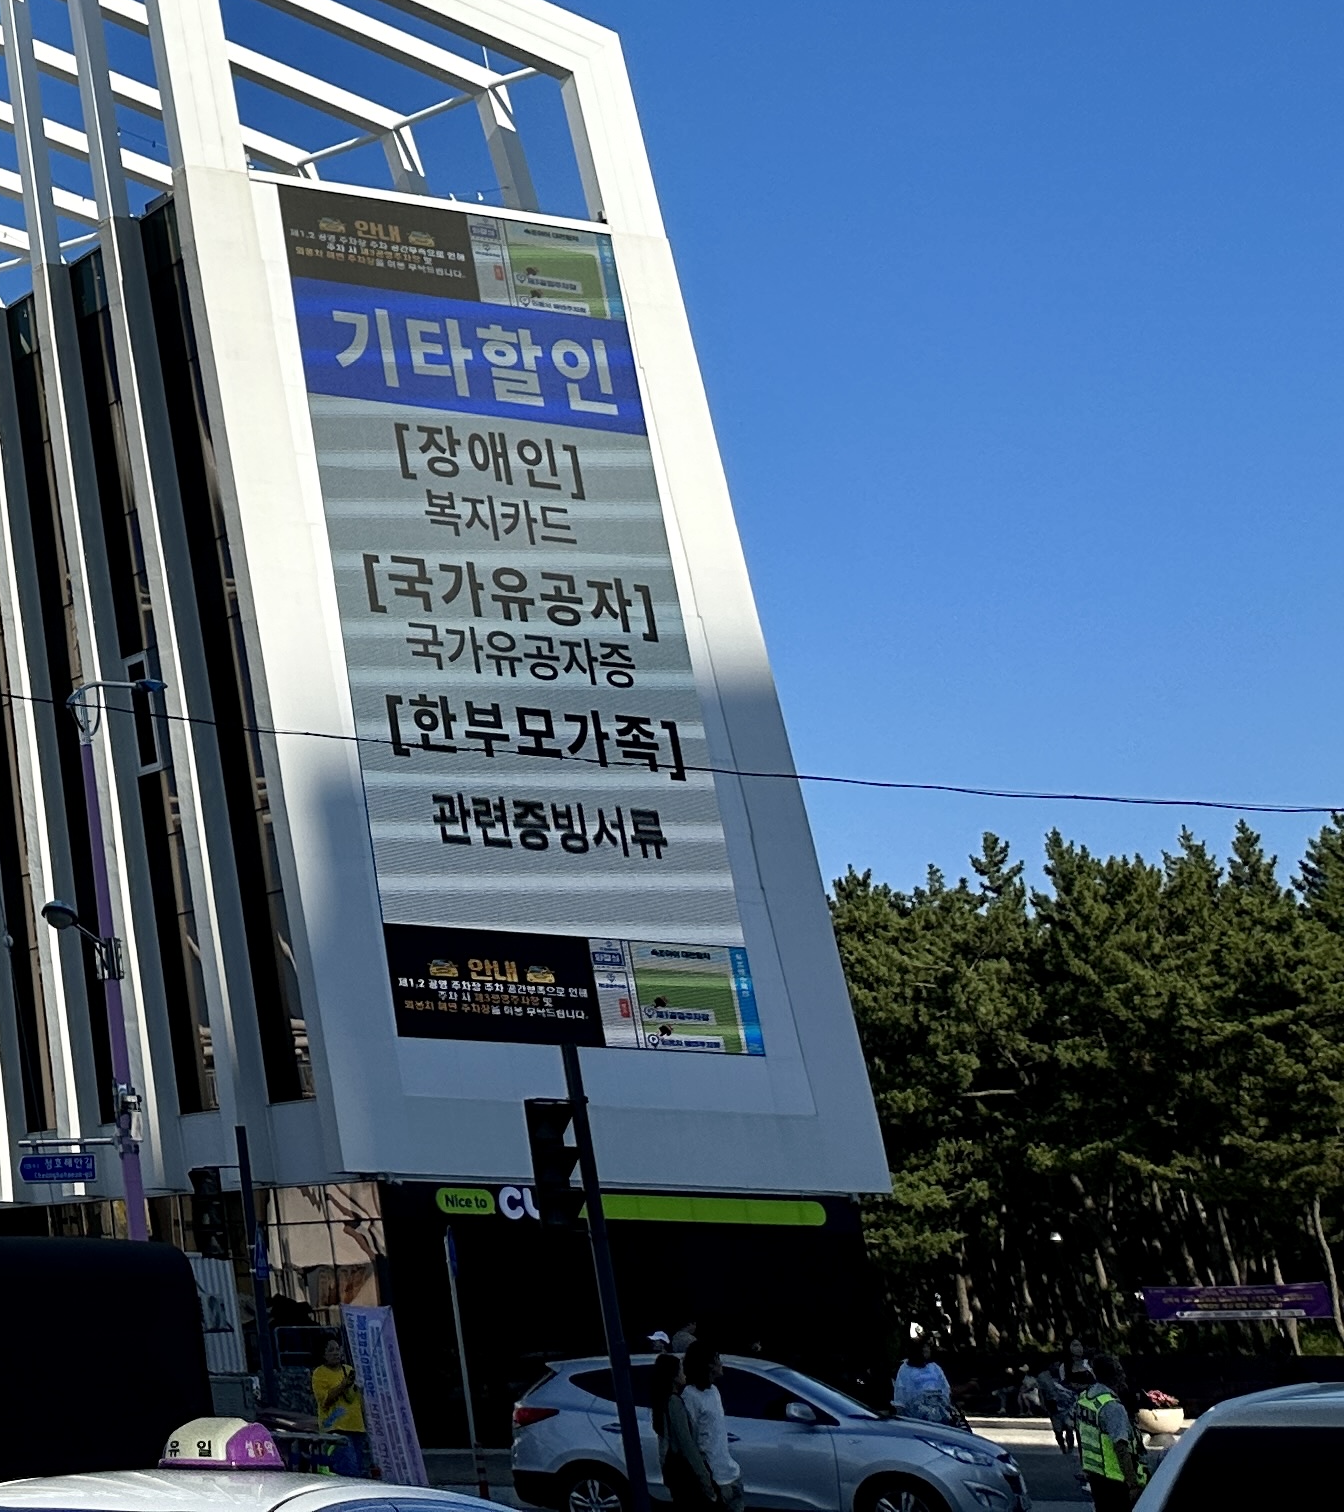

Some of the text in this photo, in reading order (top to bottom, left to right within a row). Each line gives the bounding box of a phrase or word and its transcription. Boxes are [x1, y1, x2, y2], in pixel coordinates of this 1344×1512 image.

[354, 219, 402, 243] 안내
[331, 307, 619, 416] 기타할인
[394, 422, 586, 501] [장애인]
[424, 488, 577, 546] 복지카드
[362, 552, 660, 643] [국가유공자]
[405, 621, 637, 689] 국가유공자증
[385, 693, 687, 782] [한부모가족]
[431, 791, 669, 860] 관련증빙서류
[451, 980, 482, 992] 주차장
[484, 982, 504, 992] 주차
[461, 991, 472, 1002] 시
[467, 958, 519, 983] 안내
[526, 1007, 590, 1020] 부탁드립니다.
[444, 1194, 473, 1208] Nice
[474, 1195, 488, 1209] to
